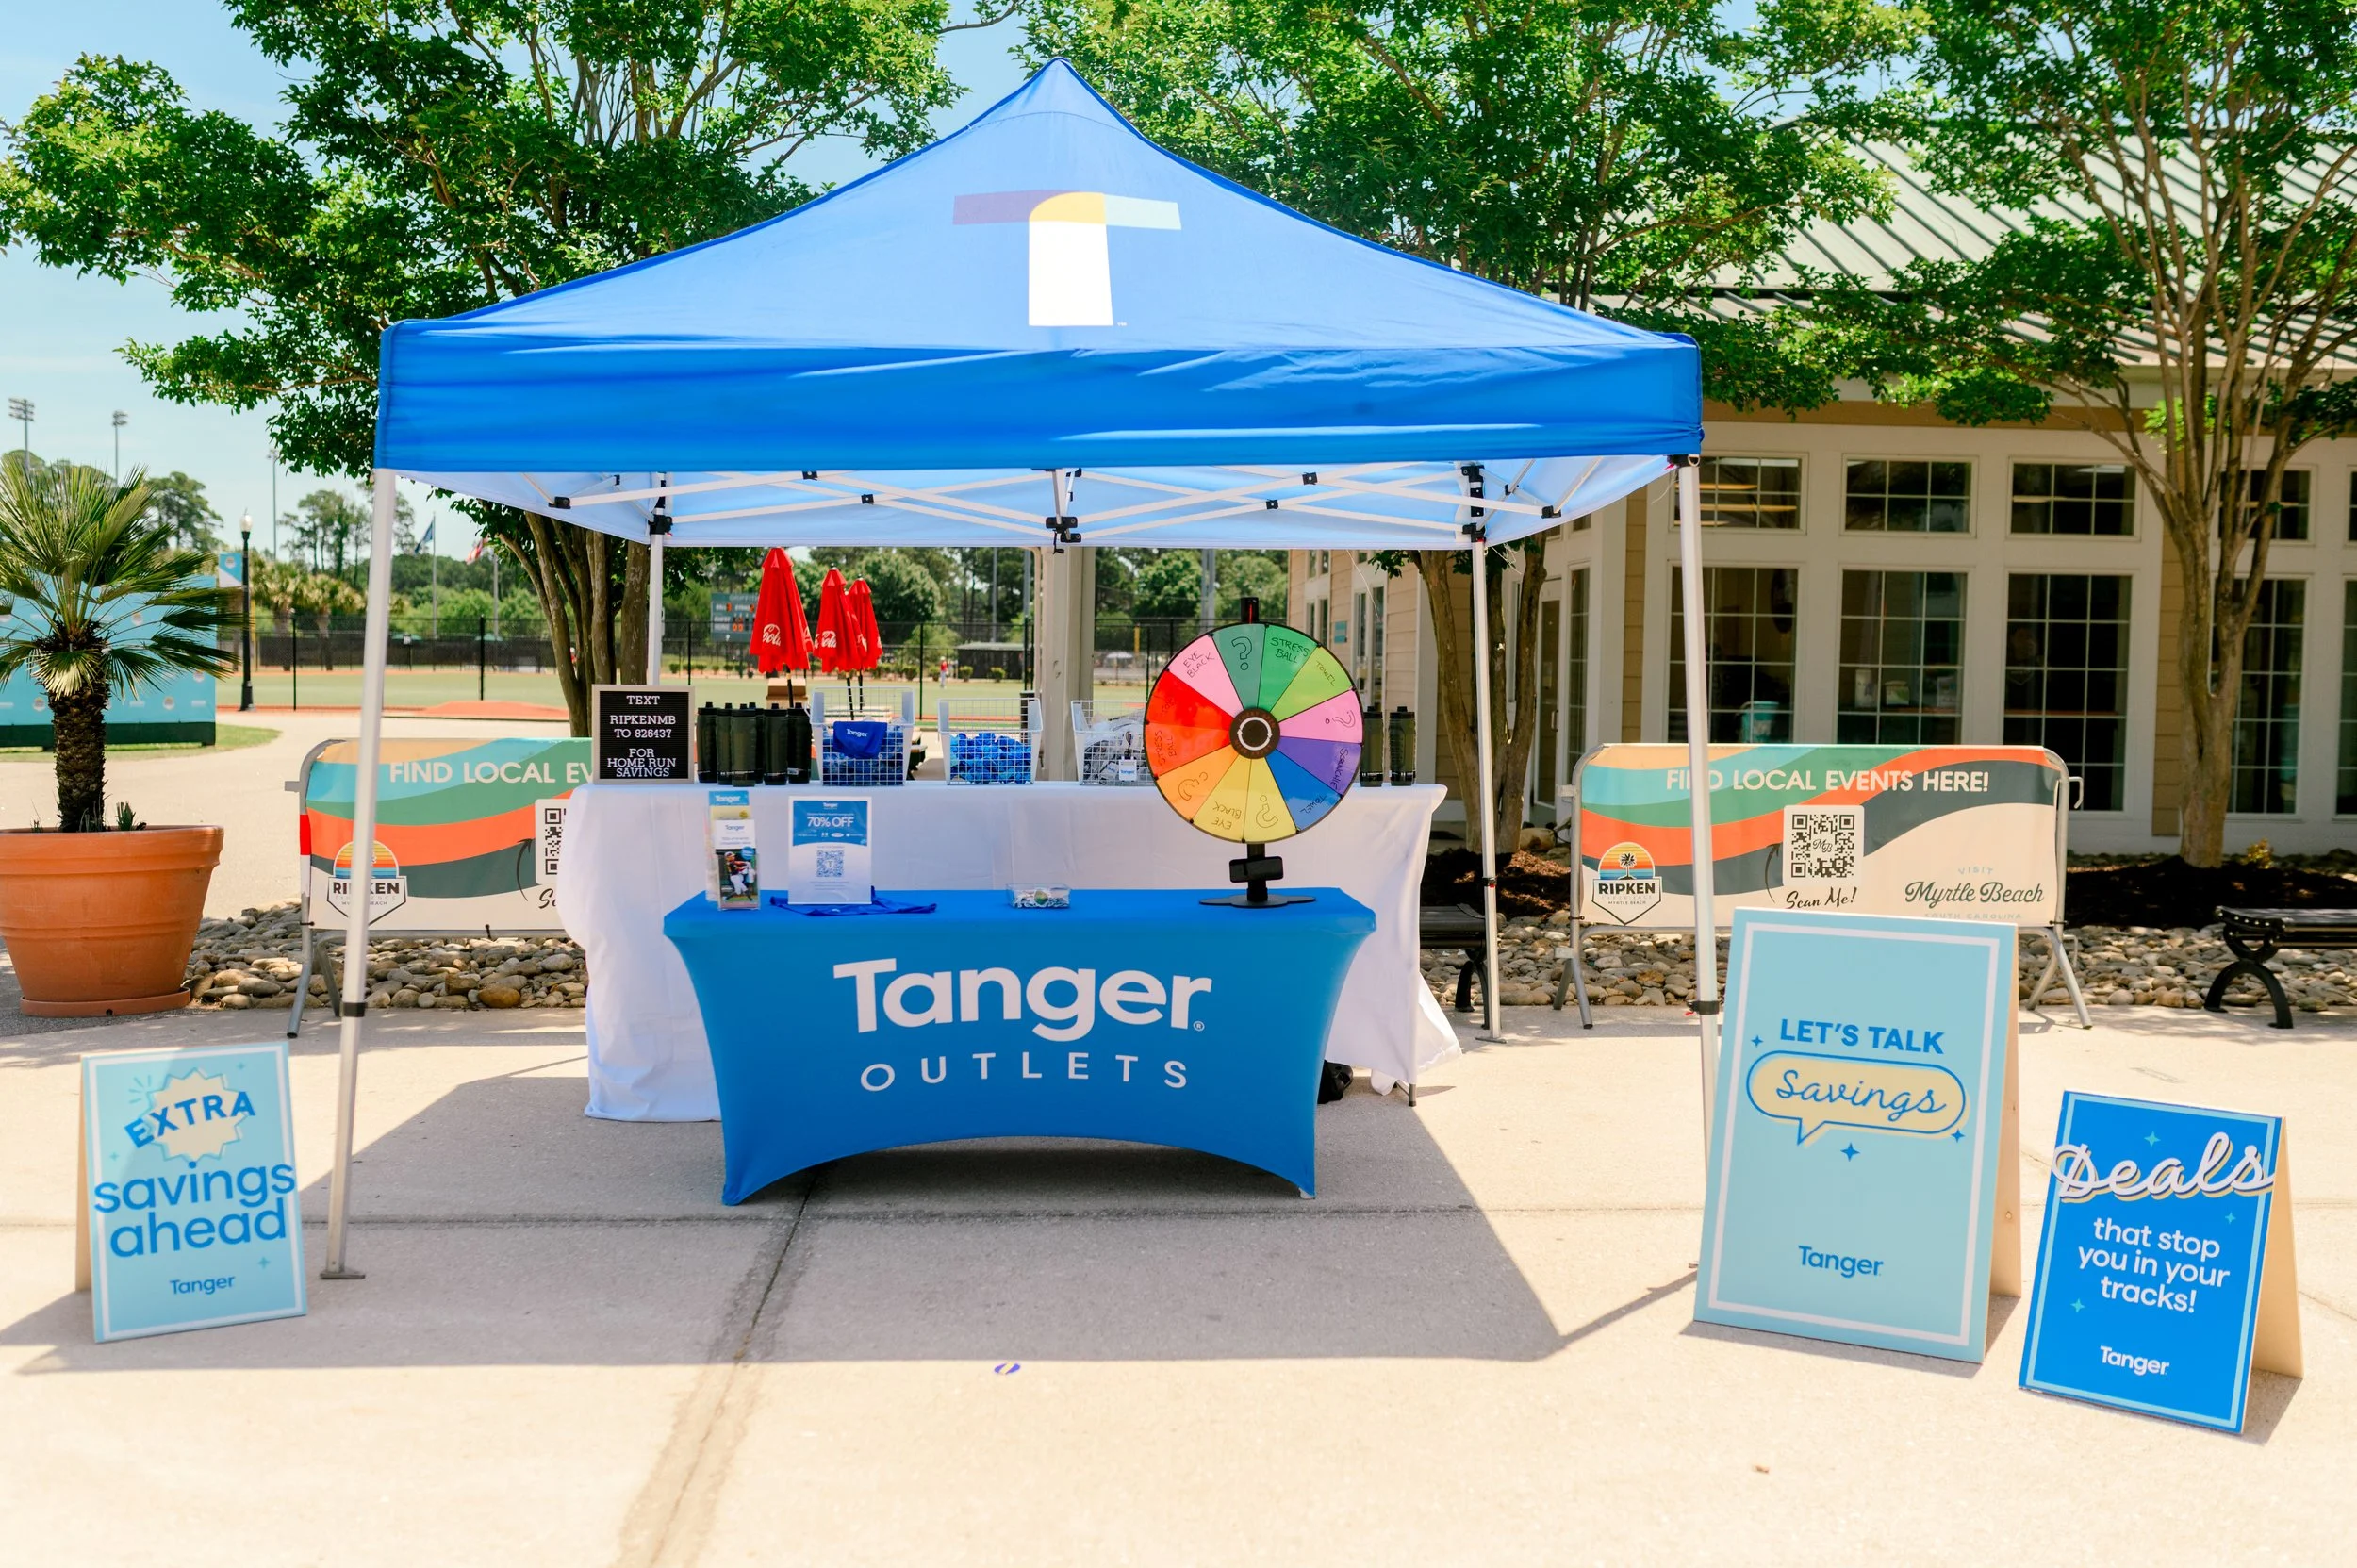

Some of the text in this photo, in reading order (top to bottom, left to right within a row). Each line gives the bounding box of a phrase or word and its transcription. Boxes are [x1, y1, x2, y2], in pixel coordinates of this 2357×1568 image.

[1270, 637, 1310, 657] STRESS
[1276, 648, 1298, 664] BALL
[1183, 651, 1204, 668] EYE
[1187, 652, 1215, 678] BLACK
[1316, 660, 1336, 686] TOWEL
[626, 695, 660, 705] TEXT
[609, 715, 676, 725] RIPKENMB
[614, 728, 672, 738] TO 826437
[846, 728, 867, 737] Tanger
[607, 757, 676, 767] HOME RUN
[629, 748, 654, 758] FOR
[389, 762, 453, 784] FIND
[463, 762, 555, 784] LOCAL
[616, 767, 670, 777] SAVINGS
[1667, 769, 1989, 792] FID LOCAL EVENTS HERE!
[1212, 800, 1242, 820] BLACK
[1300, 795, 1327, 814] TOWEL
[807, 817, 854, 827] 70% OFF
[1211, 817, 1232, 830] EYE
[1957, 866, 1994, 875] VISIT
[333, 882, 400, 894] RIEN
[1598, 883, 1656, 894] RIPKEN
[1786, 886, 1857, 909] Scan Me!
[1904, 881, 2044, 909] Myrtle Beach
[1780, 1018, 1944, 1054] LET'S TALK
[860, 1051, 1188, 1092] OUTLETS
[1775, 1069, 1946, 1121] Savings
[124, 1091, 255, 1148] EXTRA
[94, 1161, 296, 1213] savings
[110, 1197, 287, 1257] ahead
[2093, 1217, 2220, 1262] that stop
[1798, 1246, 1884, 1278] Tanger
[2078, 1246, 2231, 1288] you in your
[170, 1276, 235, 1295] Tanger
[2101, 1276, 2197, 1313] tracks!
[2100, 1345, 2170, 1377] Tanger
